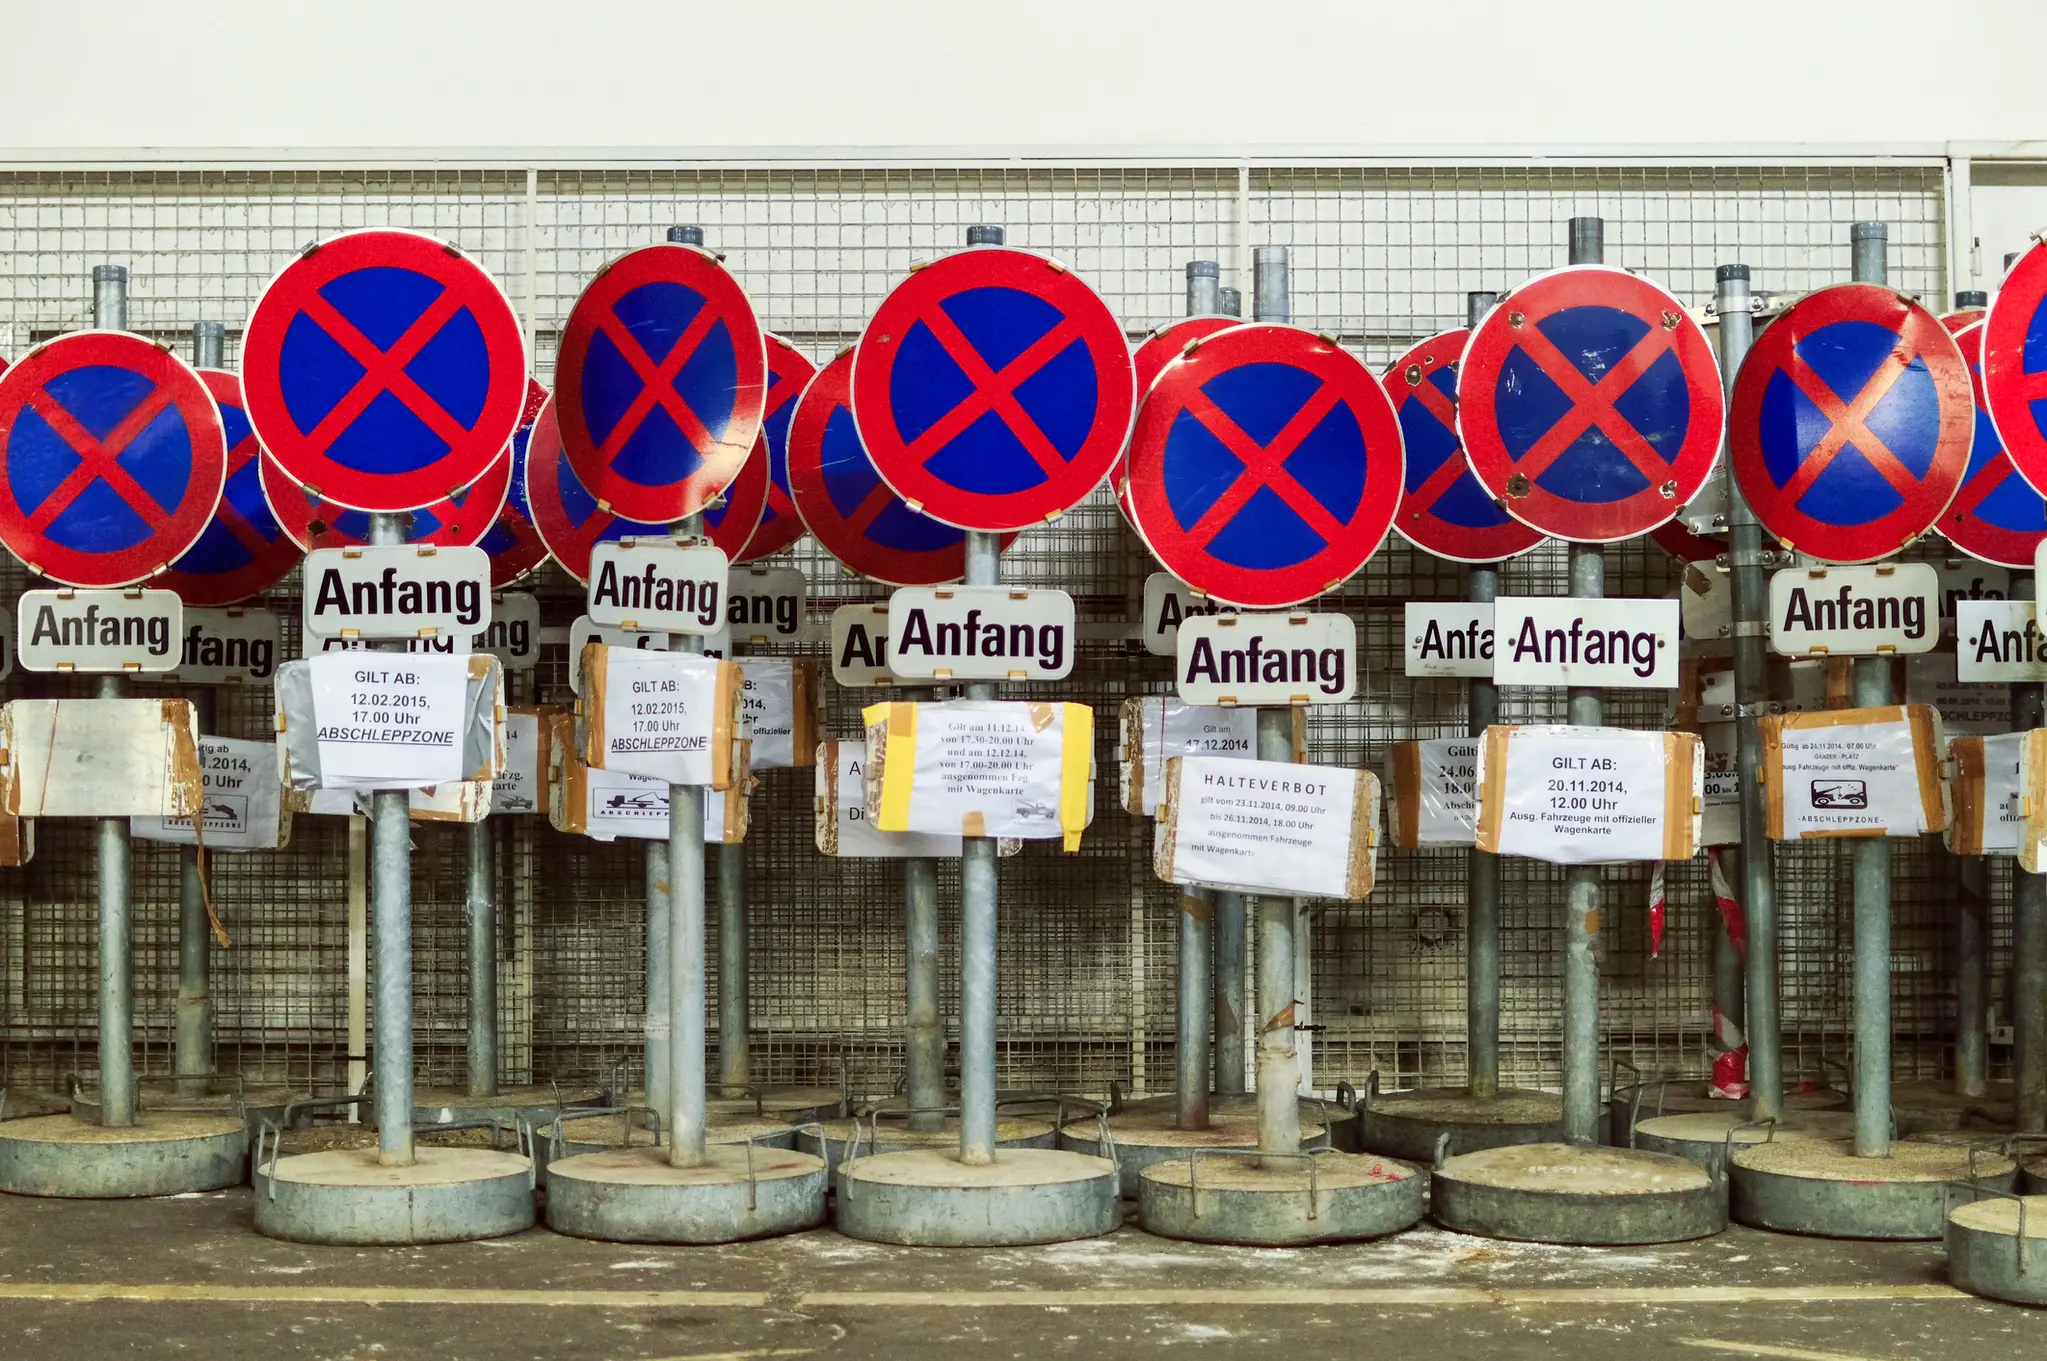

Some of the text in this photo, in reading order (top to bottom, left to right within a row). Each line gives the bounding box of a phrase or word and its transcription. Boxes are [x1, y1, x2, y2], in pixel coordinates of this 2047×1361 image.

[314, 568, 481, 625] Anfang
[594, 560, 719, 626] Anfang
[1783, 585, 1925, 639] Anfang
[31, 604, 170, 655] Anfang
[898, 608, 1064, 670] Anfang
[182, 626, 274, 678] fang
[1513, 616, 1656, 678] Anfang
[1185, 635, 1345, 694] Anfang
[355, 671, 420, 685] GILT AB:
[632, 680, 680, 693] GILT AB:
[350, 693, 430, 710] 12.02.2015,
[631, 702, 687, 715] 12.02.2015,
[352, 711, 421, 725] 17.00 Uhr
[633, 720, 680, 733] 17.00 Uhr
[753, 727, 791, 735] offizieller
[948, 722, 966, 732] Gilt
[969, 724, 984, 732] am
[1203, 725, 1231, 734] Gilt am
[317, 727, 455, 744] ABSCHLEPPZONE
[940, 735, 957, 743] von
[1016, 736, 1035, 746] Uhr
[217, 745, 230, 753] ab
[611, 736, 707, 750] ABSCHLEPPZONE
[1801, 742, 1810, 750] ab
[947, 749, 966, 757] und
[968, 750, 983, 758] am
[940, 761, 957, 769] von
[1015, 762, 1034, 771] Uhr
[1552, 757, 1617, 771] GILT AB:
[1798, 763, 1830, 772] Fahrzeuge
[216, 776, 243, 789] Uhr
[941, 773, 1008, 783] ausgenommen
[947, 785, 1025, 795] mit Wagenkarte
[1204, 774, 1328, 796] HALTEVERBOT
[1548, 779, 1628, 795] 20.11.2014,
[1200, 796, 1326, 815] gilt vom 23.11.2014, 09.00 Uhr
[1550, 797, 1618, 810] 12.00 Uhr
[1210, 812, 1314, 830] bis 26.11.2014, 18.00 Uhr
[1509, 811, 1657, 824] Ausg. Fahrzeuge mit offizieller
[1554, 825, 1612, 835] Wagenkarte
[1207, 829, 1313, 847] ausgenommen Fahrzeuge
[1191, 843, 1205, 852] mit
